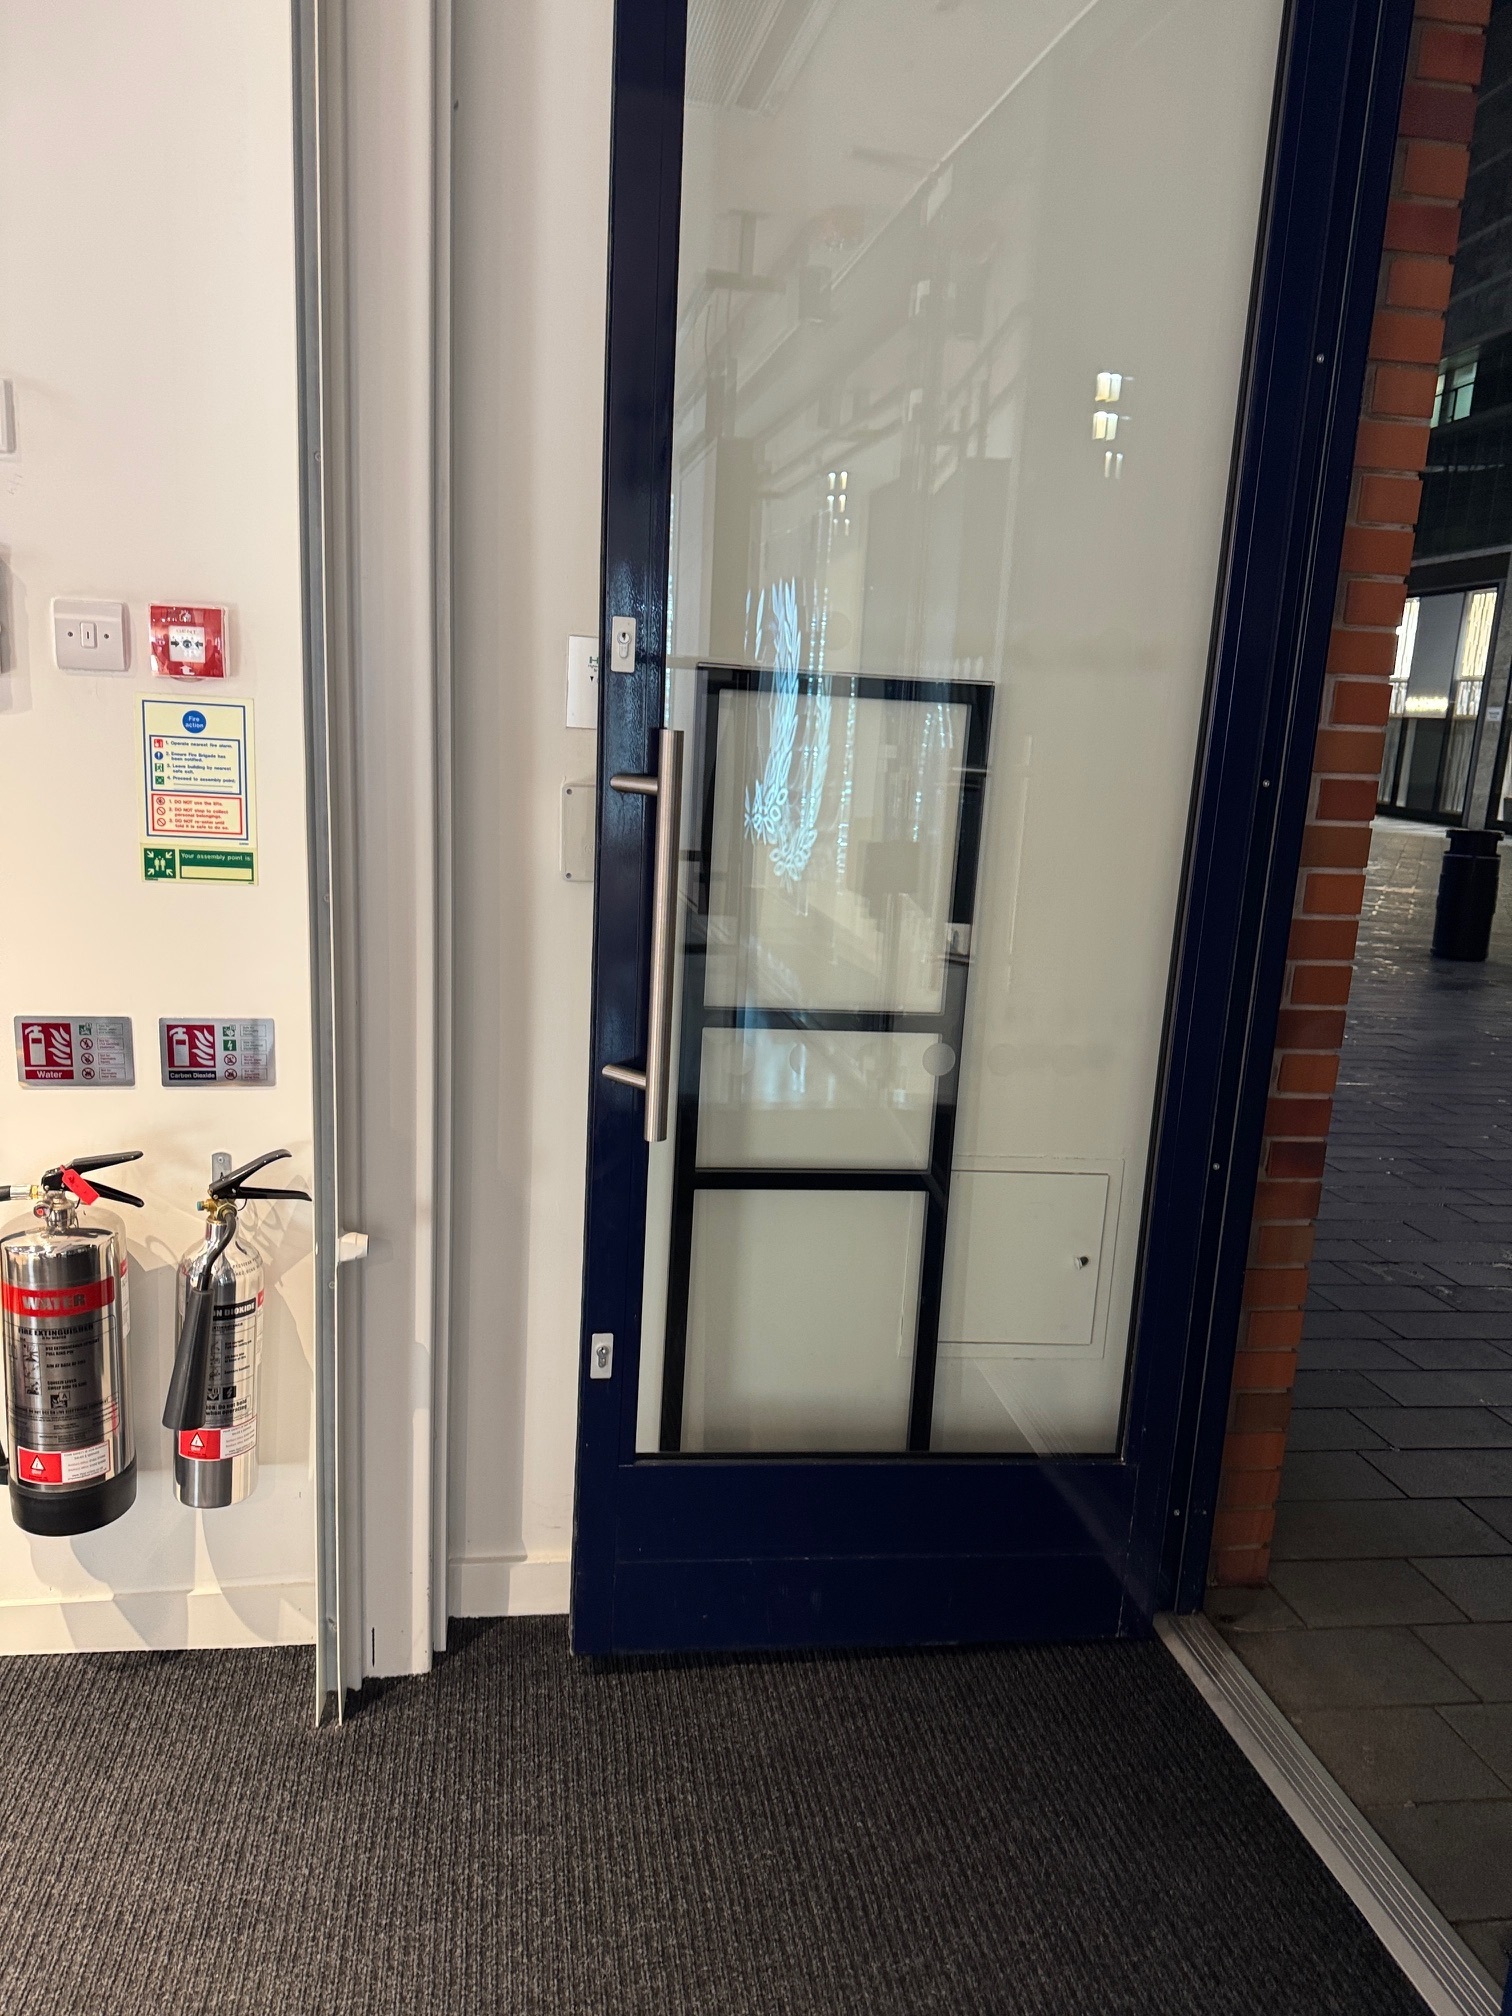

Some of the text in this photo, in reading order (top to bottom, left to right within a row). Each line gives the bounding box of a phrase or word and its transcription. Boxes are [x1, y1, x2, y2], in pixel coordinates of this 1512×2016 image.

[37, 1070, 62, 1078] Water
[22, 1294, 85, 1310] WATER
[225, 1302, 255, 1315] DIOXIDE
[18, 1323, 93, 1337] FIRE EXTINGUISHER
